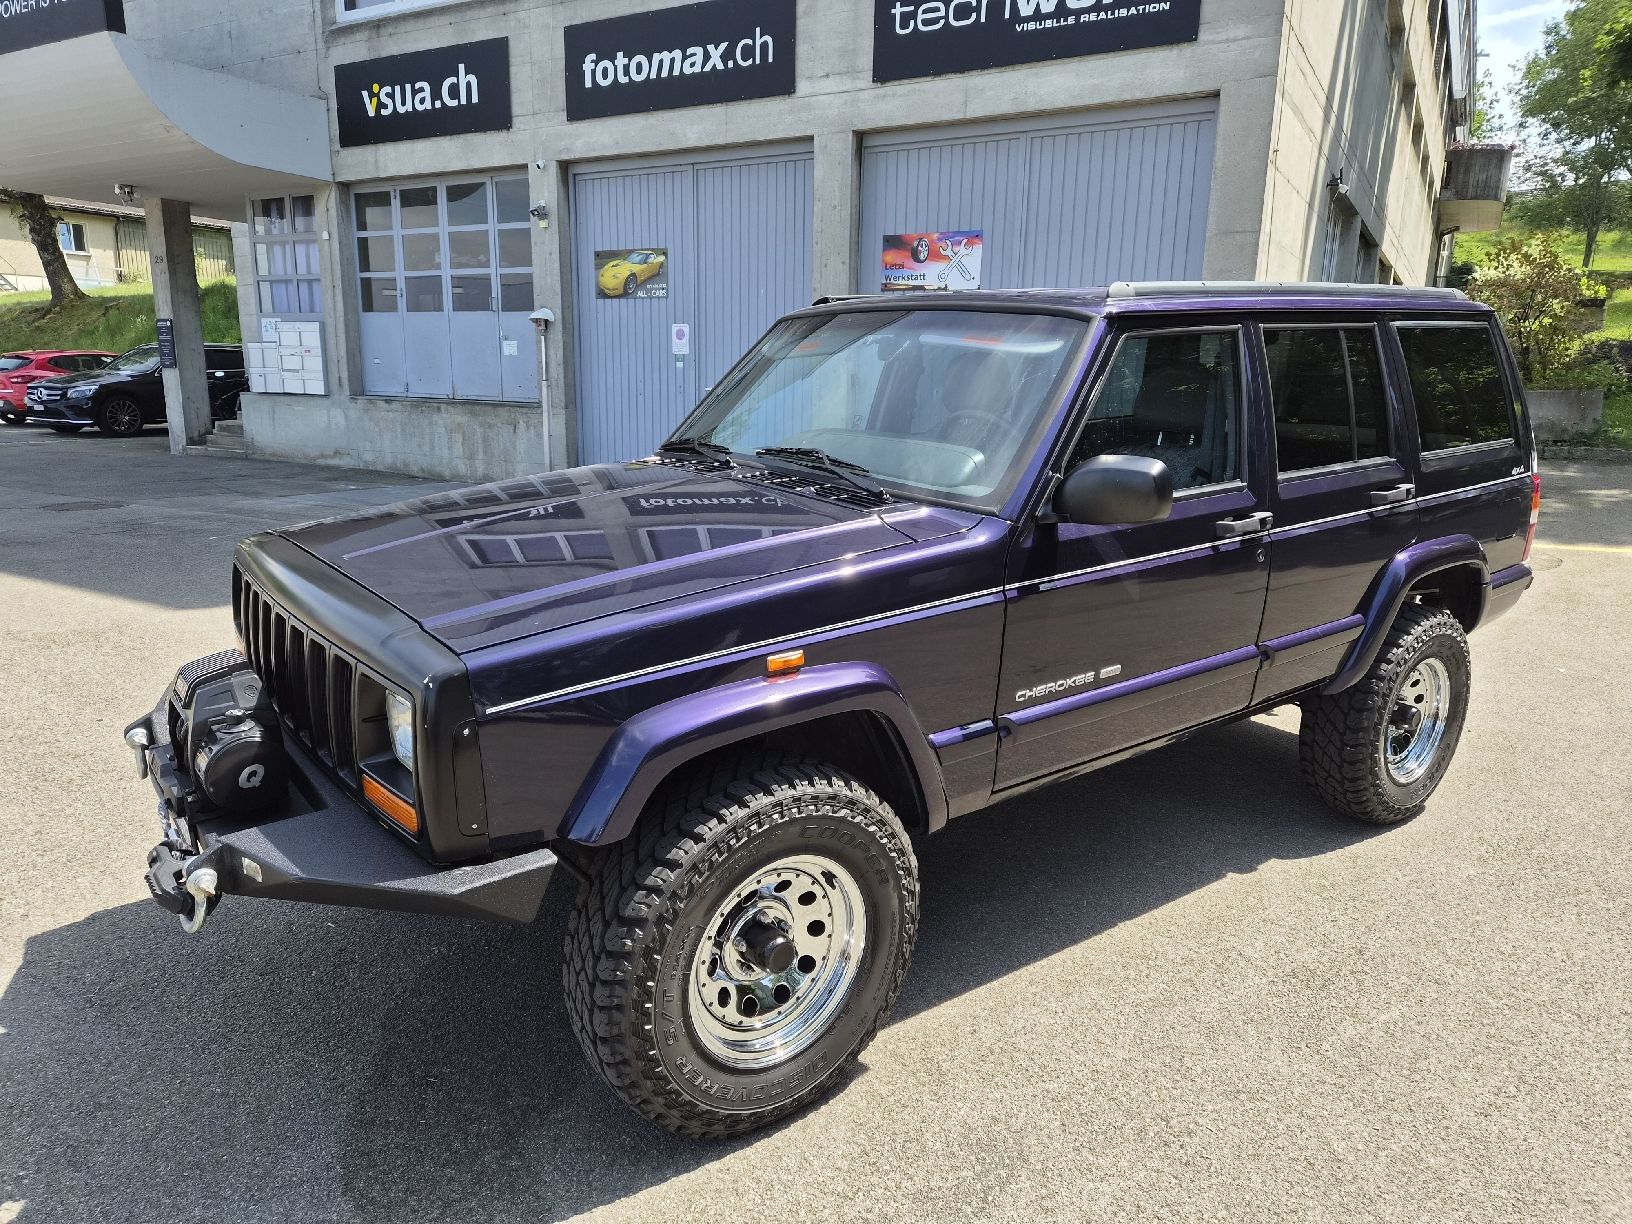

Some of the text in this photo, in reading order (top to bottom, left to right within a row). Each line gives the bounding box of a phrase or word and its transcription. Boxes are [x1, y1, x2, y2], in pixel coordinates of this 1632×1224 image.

[0, 0, 36, 18] OWER
[1015, 1, 1171, 32] VISUELLE REALISATION
[582, 26, 774, 88] fotomax.ch
[360, 63, 479, 117] visua.ch
[154, 255, 164, 264] 29
[884, 262, 905, 271] Letzi
[651, 289, 667, 297] CARS
[884, 273, 927, 282] Werkstatt
[1015, 671, 1096, 702] CHEROKEE
[799, 825, 890, 886] COOPER
[675, 1050, 828, 1102] DISCOVERER
